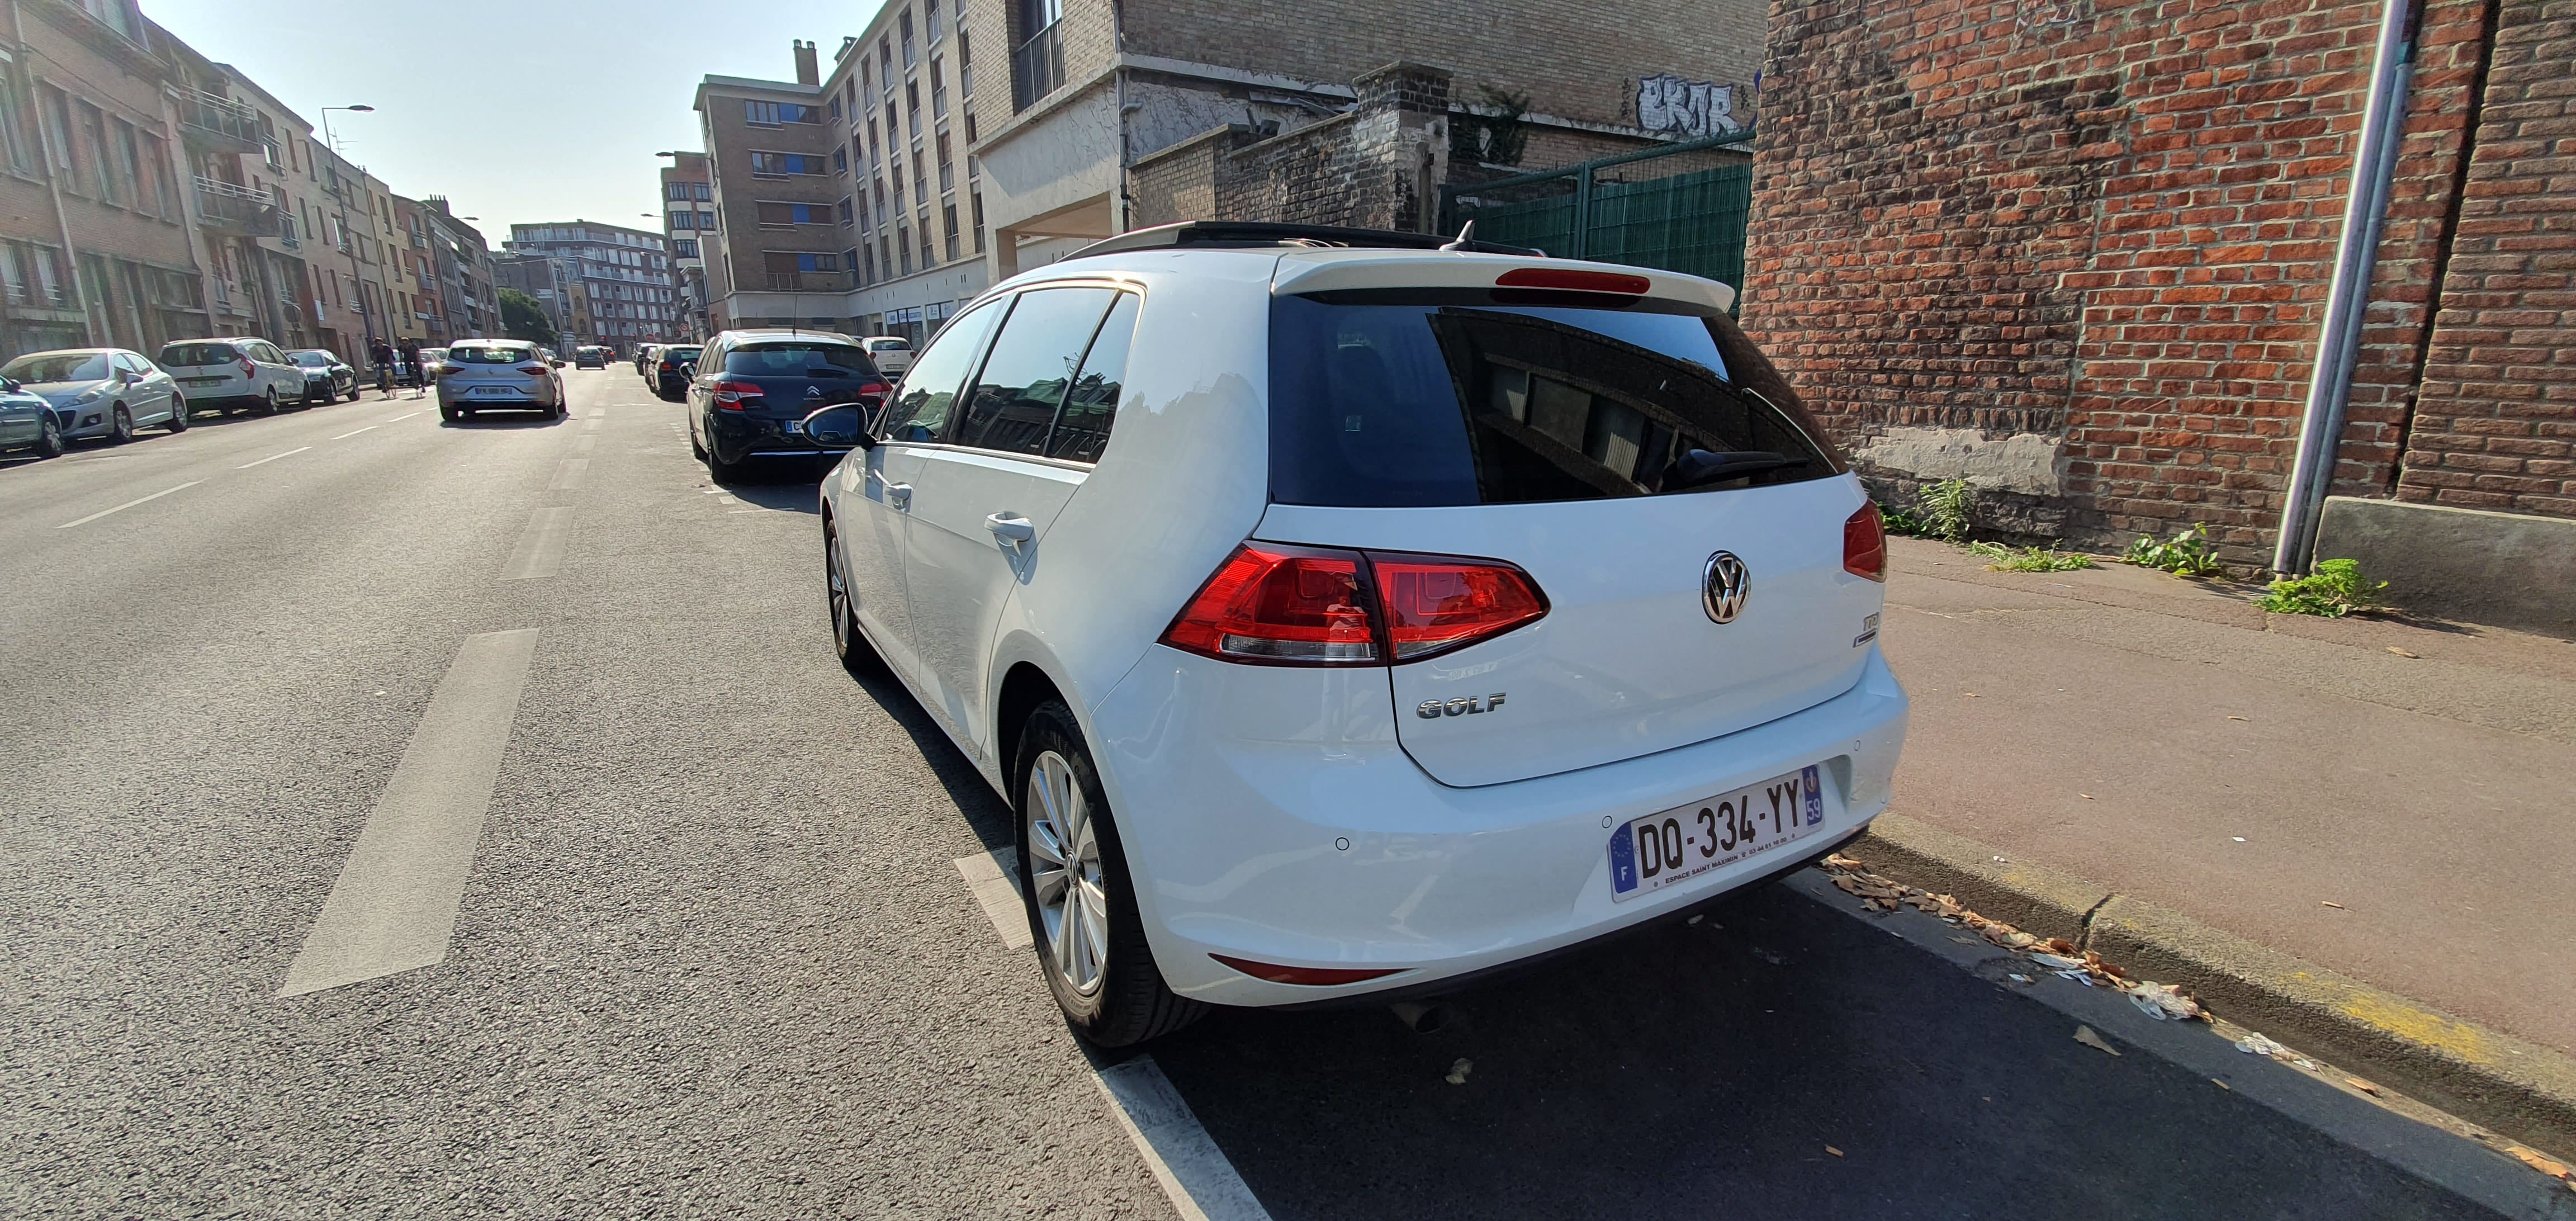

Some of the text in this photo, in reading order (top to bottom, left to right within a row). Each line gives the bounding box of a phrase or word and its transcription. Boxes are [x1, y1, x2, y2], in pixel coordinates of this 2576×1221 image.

[1416, 692, 1507, 719] GOLF
[1806, 798, 1821, 821] 59
[1638, 779, 1799, 879] DQ-334-YY
[1620, 865, 1628, 882] F
[1665, 871, 1690, 884] ESPACE
[1692, 864, 1711, 875] SAINT
[1712, 855, 1739, 868] MAXIMIN
